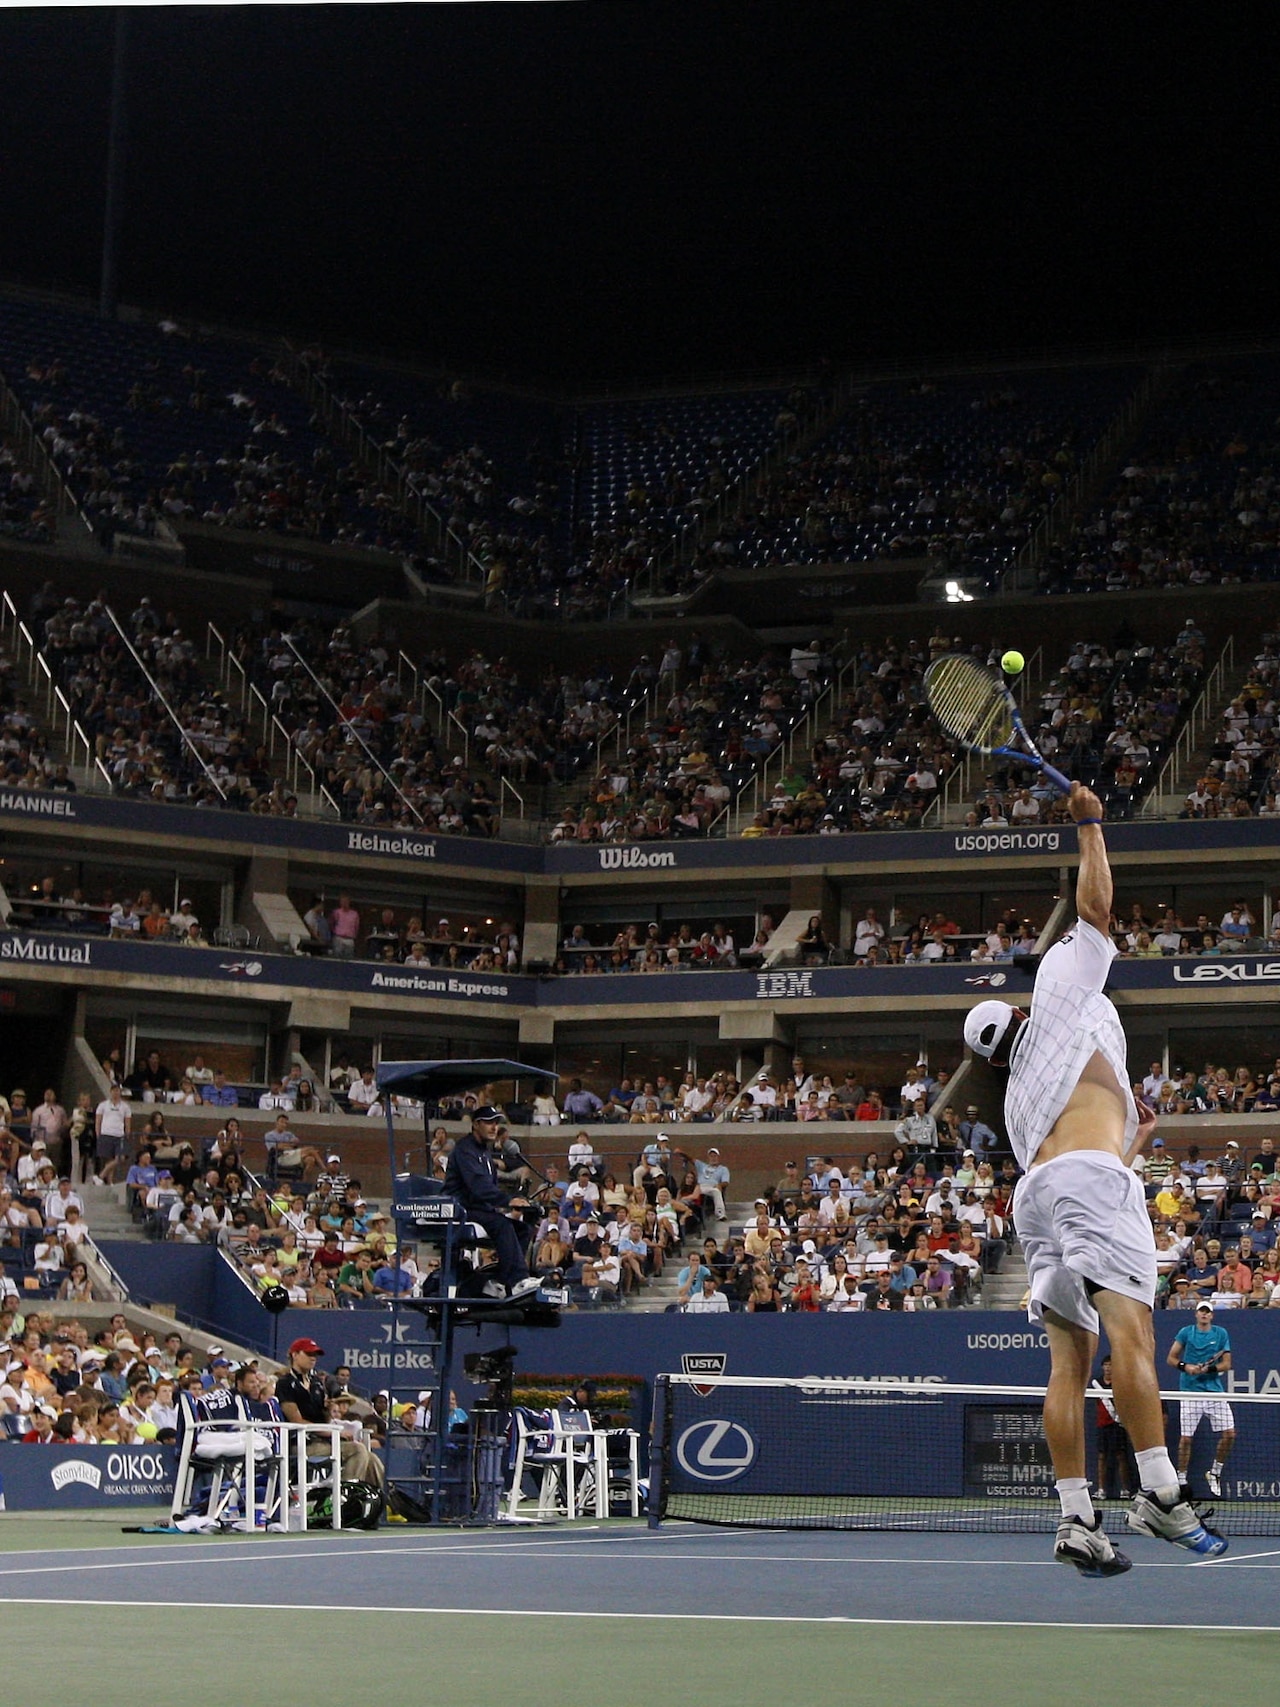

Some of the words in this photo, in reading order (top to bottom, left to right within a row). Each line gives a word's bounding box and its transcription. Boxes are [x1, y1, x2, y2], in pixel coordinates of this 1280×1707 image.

[348, 832, 435, 857] Heineken
[955, 832, 1060, 852] usopen.org
[599, 846, 677, 869] Wilson
[1, 937, 91, 964] sMutual
[371, 972, 446, 991] American
[448, 979, 508, 996] Express
[756, 972, 813, 998] IBM
[967, 1333, 1050, 1351] usopen.o
[343, 1349, 434, 1368] Heineke
[690, 1359, 721, 1369] USTA
[992, 1414, 1046, 1439] IBM
[107, 1453, 163, 1480] OIKOS
[1012, 1465, 1055, 1482] MPH
[986, 1485, 1049, 1498] usopen.org
